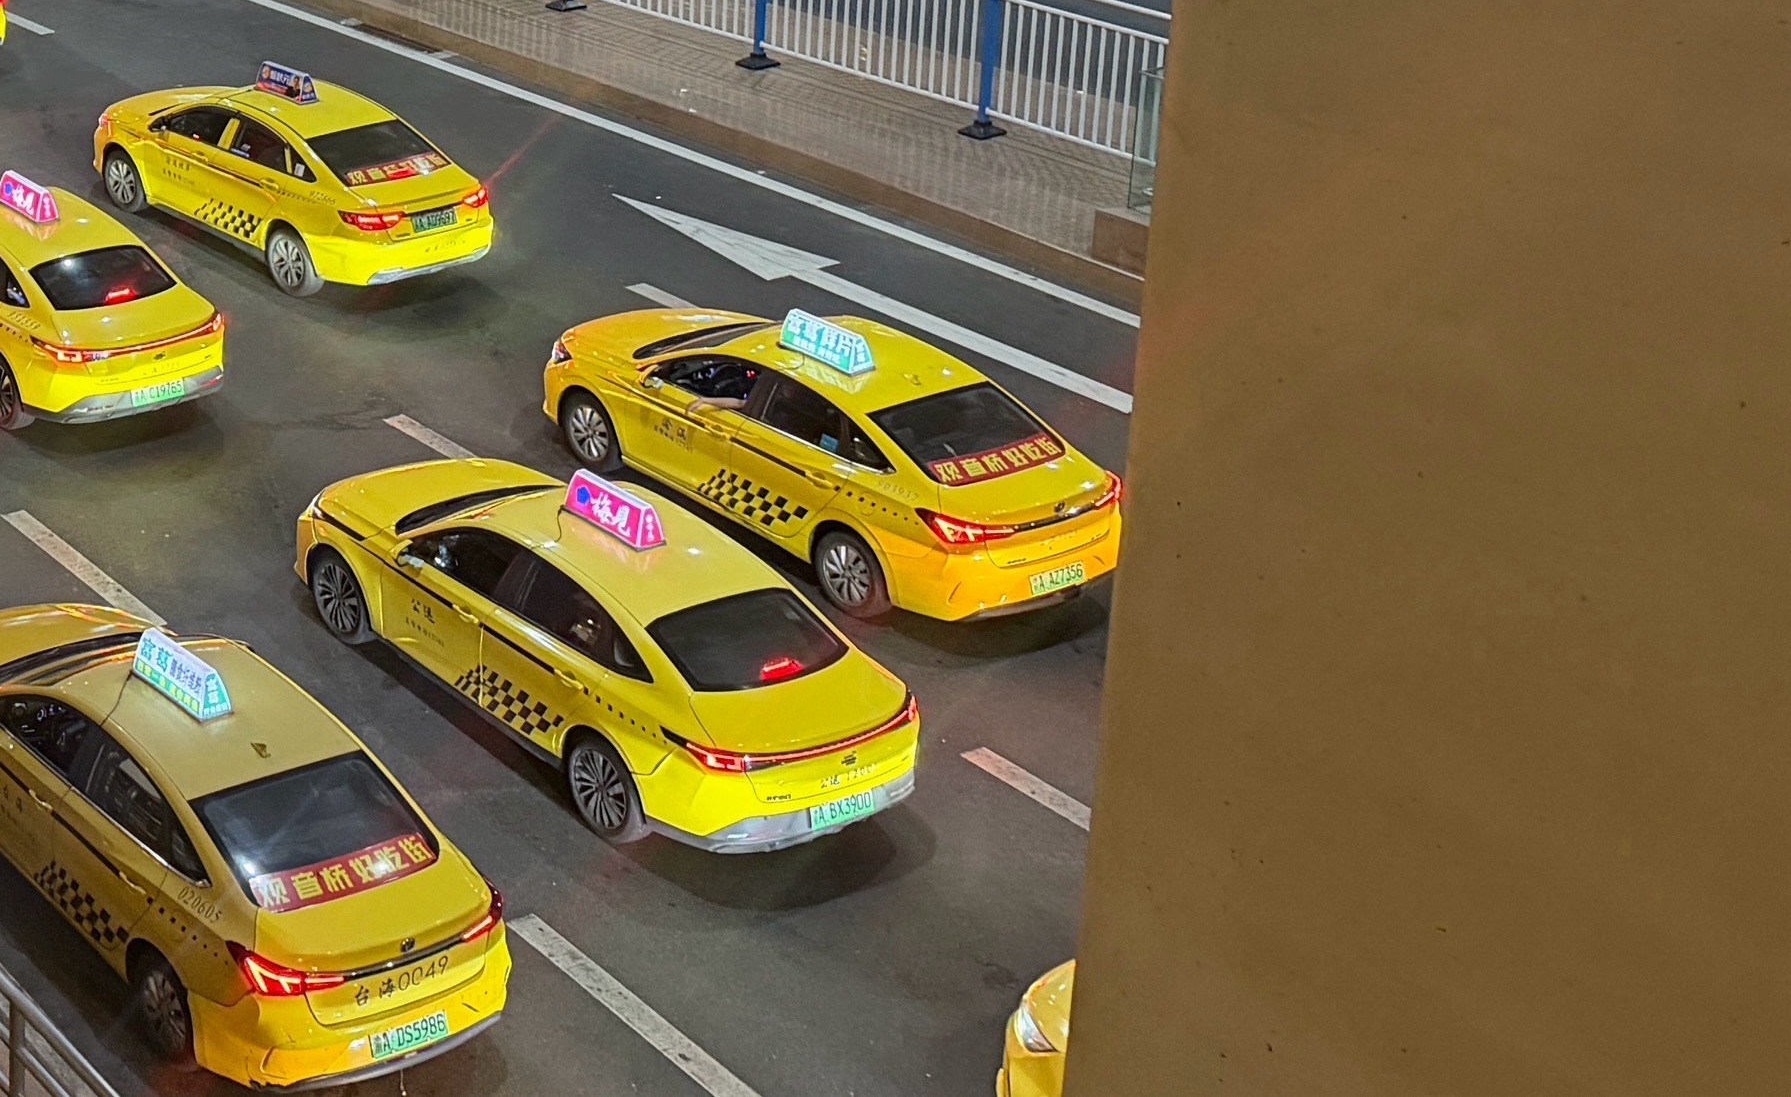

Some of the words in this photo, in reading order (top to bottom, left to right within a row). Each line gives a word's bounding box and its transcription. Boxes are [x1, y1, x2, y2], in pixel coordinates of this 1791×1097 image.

[935, 437, 1062, 483] 观音桥好吃街
[1049, 563, 1083, 585] AZ7356
[829, 792, 871, 820] BX3900
[258, 837, 432, 908] 观音桥好吃街
[397, 1013, 446, 1048] DS5986
